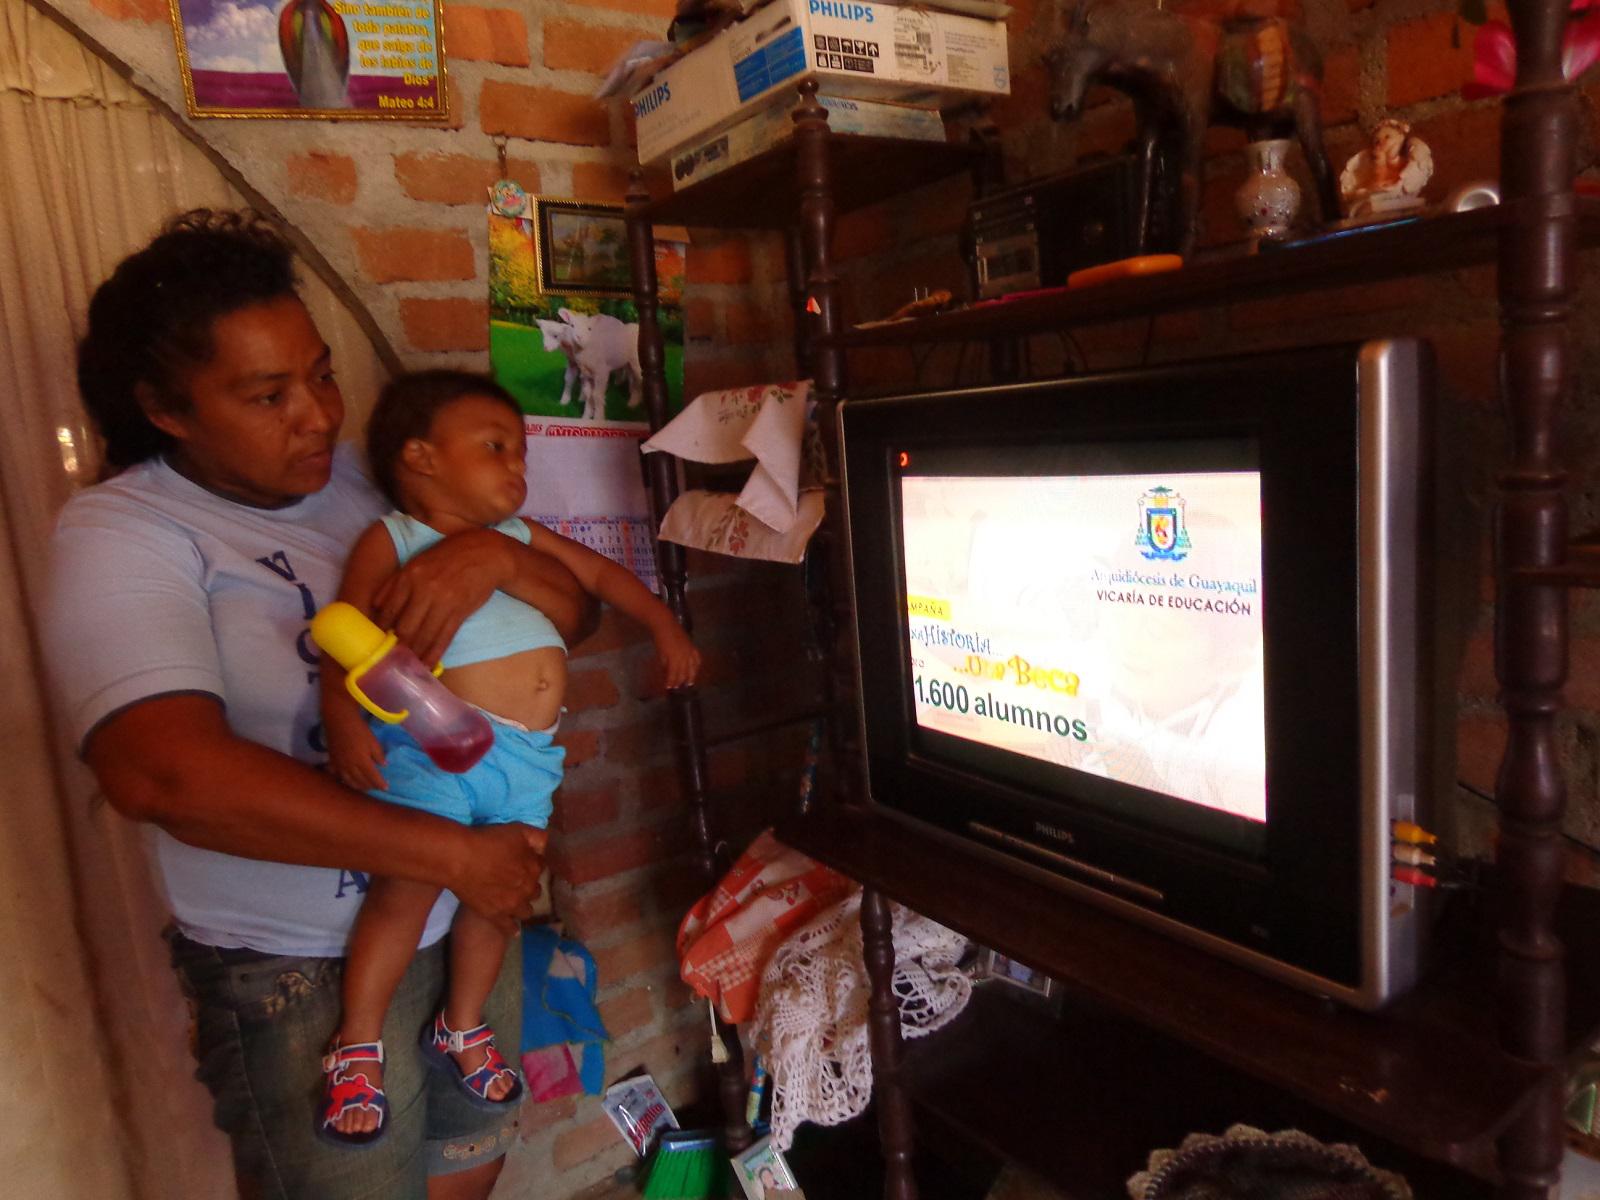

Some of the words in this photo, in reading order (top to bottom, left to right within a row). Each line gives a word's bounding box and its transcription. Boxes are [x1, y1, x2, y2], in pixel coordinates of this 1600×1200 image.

[809, 0, 875, 23] PHILIPS
[378, 95, 414, 109] Mateo
[417, 97, 434, 109] 4:4
[633, 81, 672, 118] PHILIPS
[1169, 573, 1186, 588] de
[1188, 573, 1258, 597] Guayaquil
[1096, 589, 1145, 605] VICARÍA
[1148, 594, 1165, 607] DE
[1168, 595, 1252, 616] EDUCACIÓN
[915, 675, 970, 714] 1.600
[974, 692, 1089, 742] alumnos
[1035, 821, 1074, 844] PHILIPS
